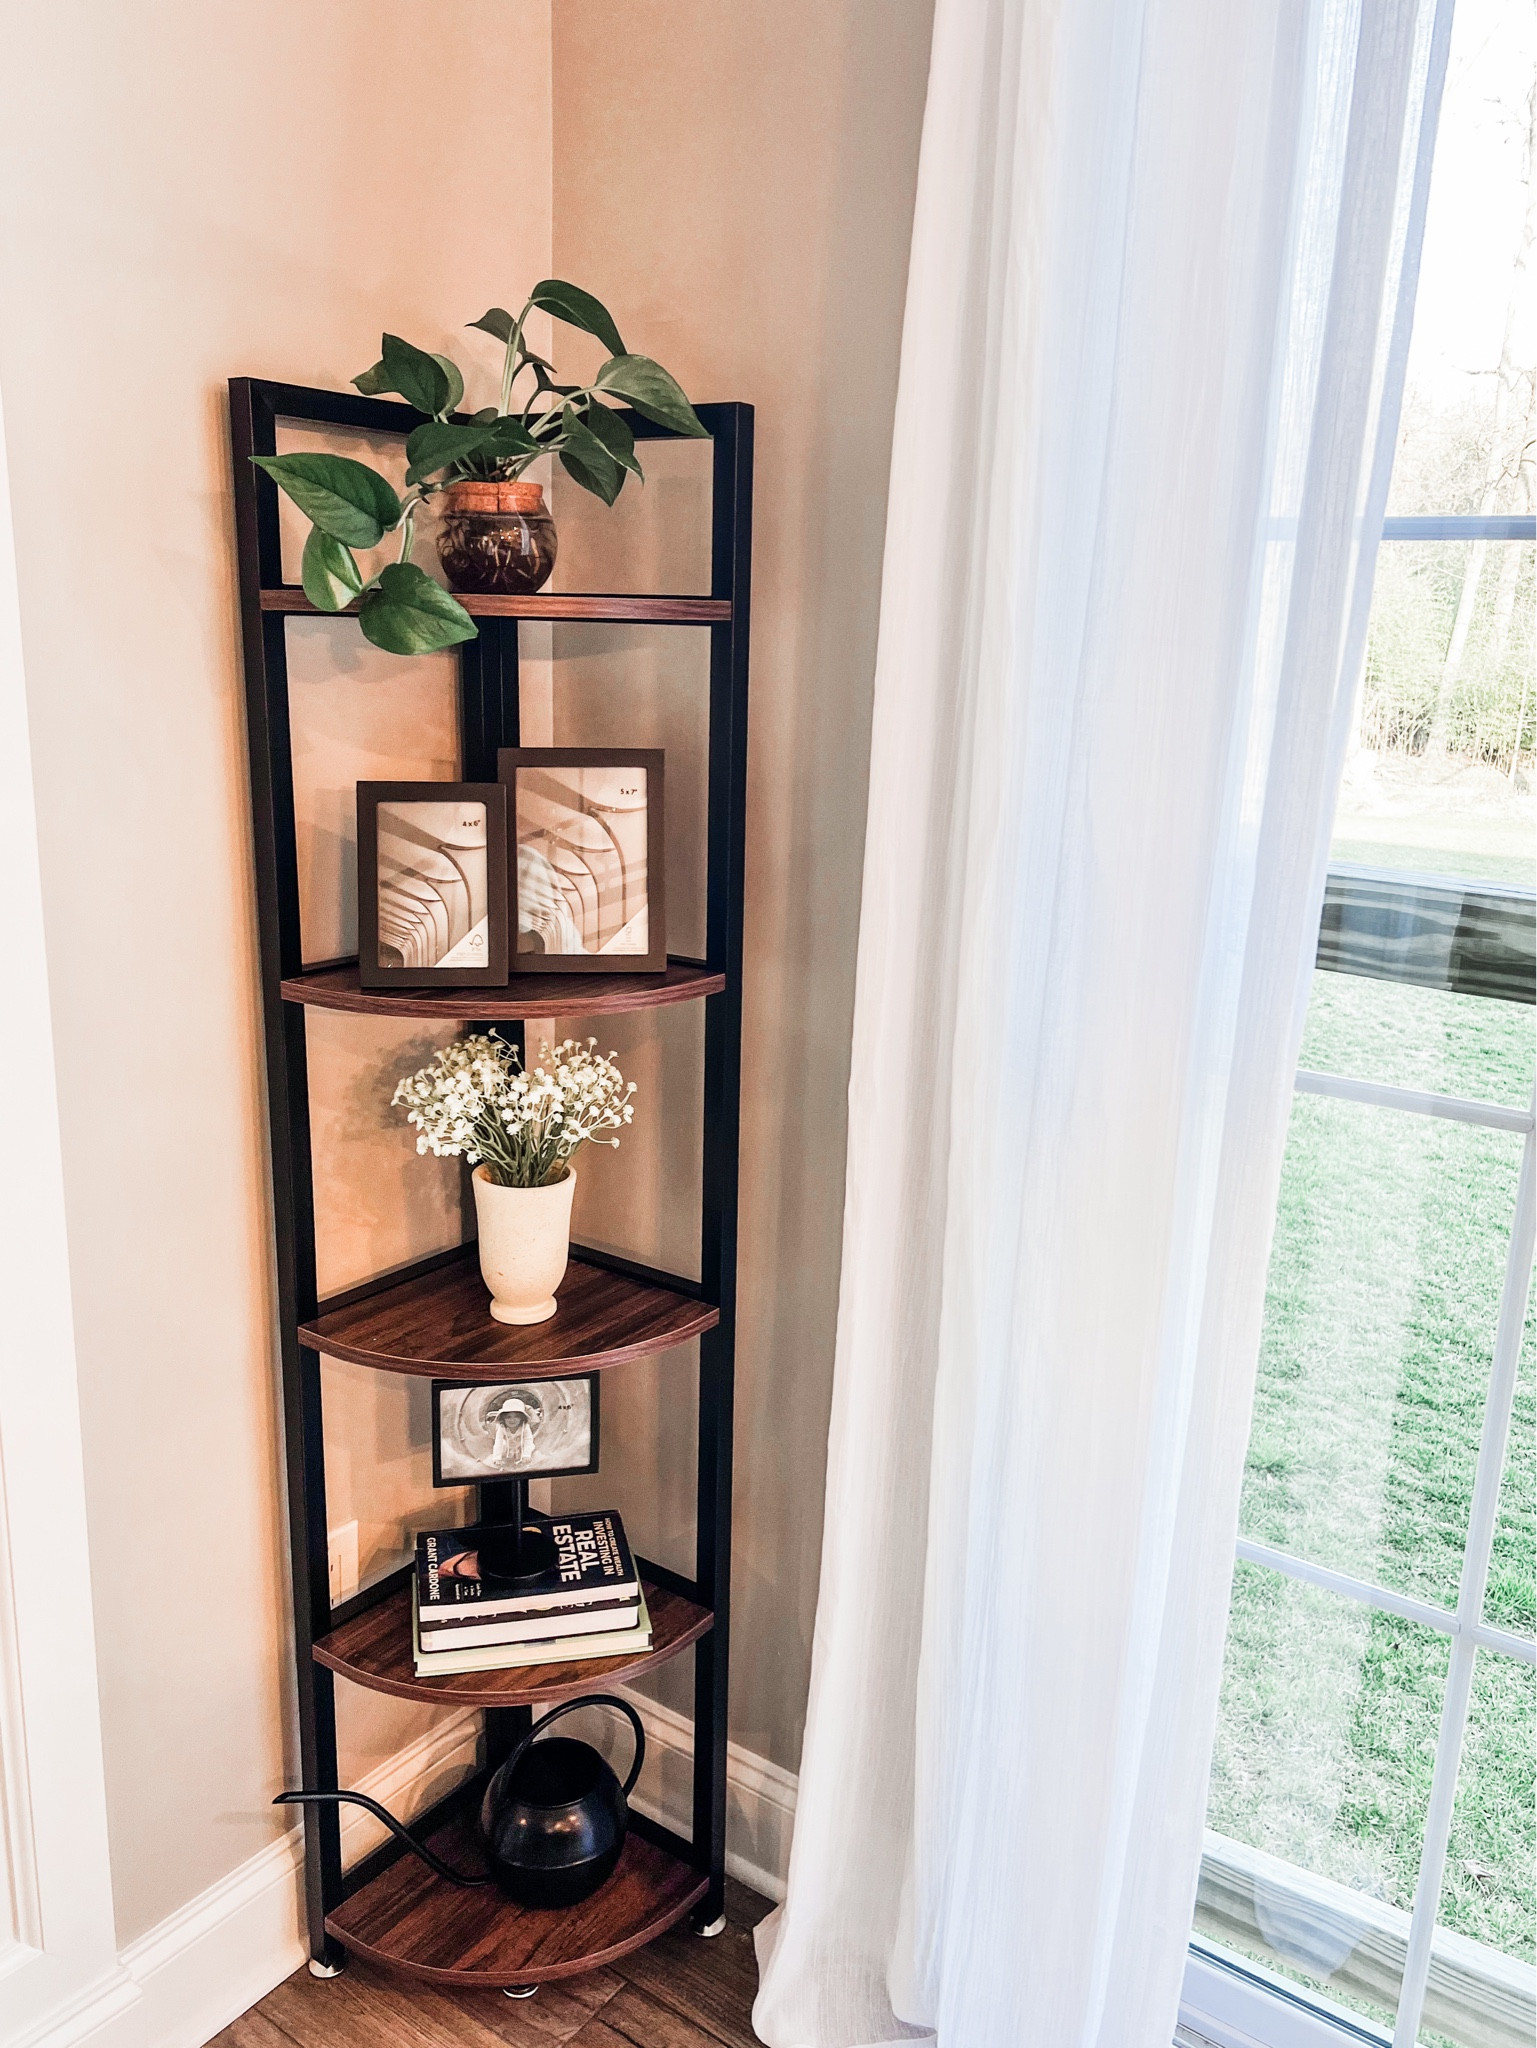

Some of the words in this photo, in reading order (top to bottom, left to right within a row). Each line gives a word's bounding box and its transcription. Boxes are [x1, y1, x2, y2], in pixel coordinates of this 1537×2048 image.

[426, 1537, 438, 1563] GRANT
[552, 1524, 582, 1583] ESTATE
[574, 1529, 601, 1572] REAL
[592, 1520, 613, 1566] INVESTING
[428, 1563, 441, 1601] CARDONE
[602, 1565, 616, 1576] IN
